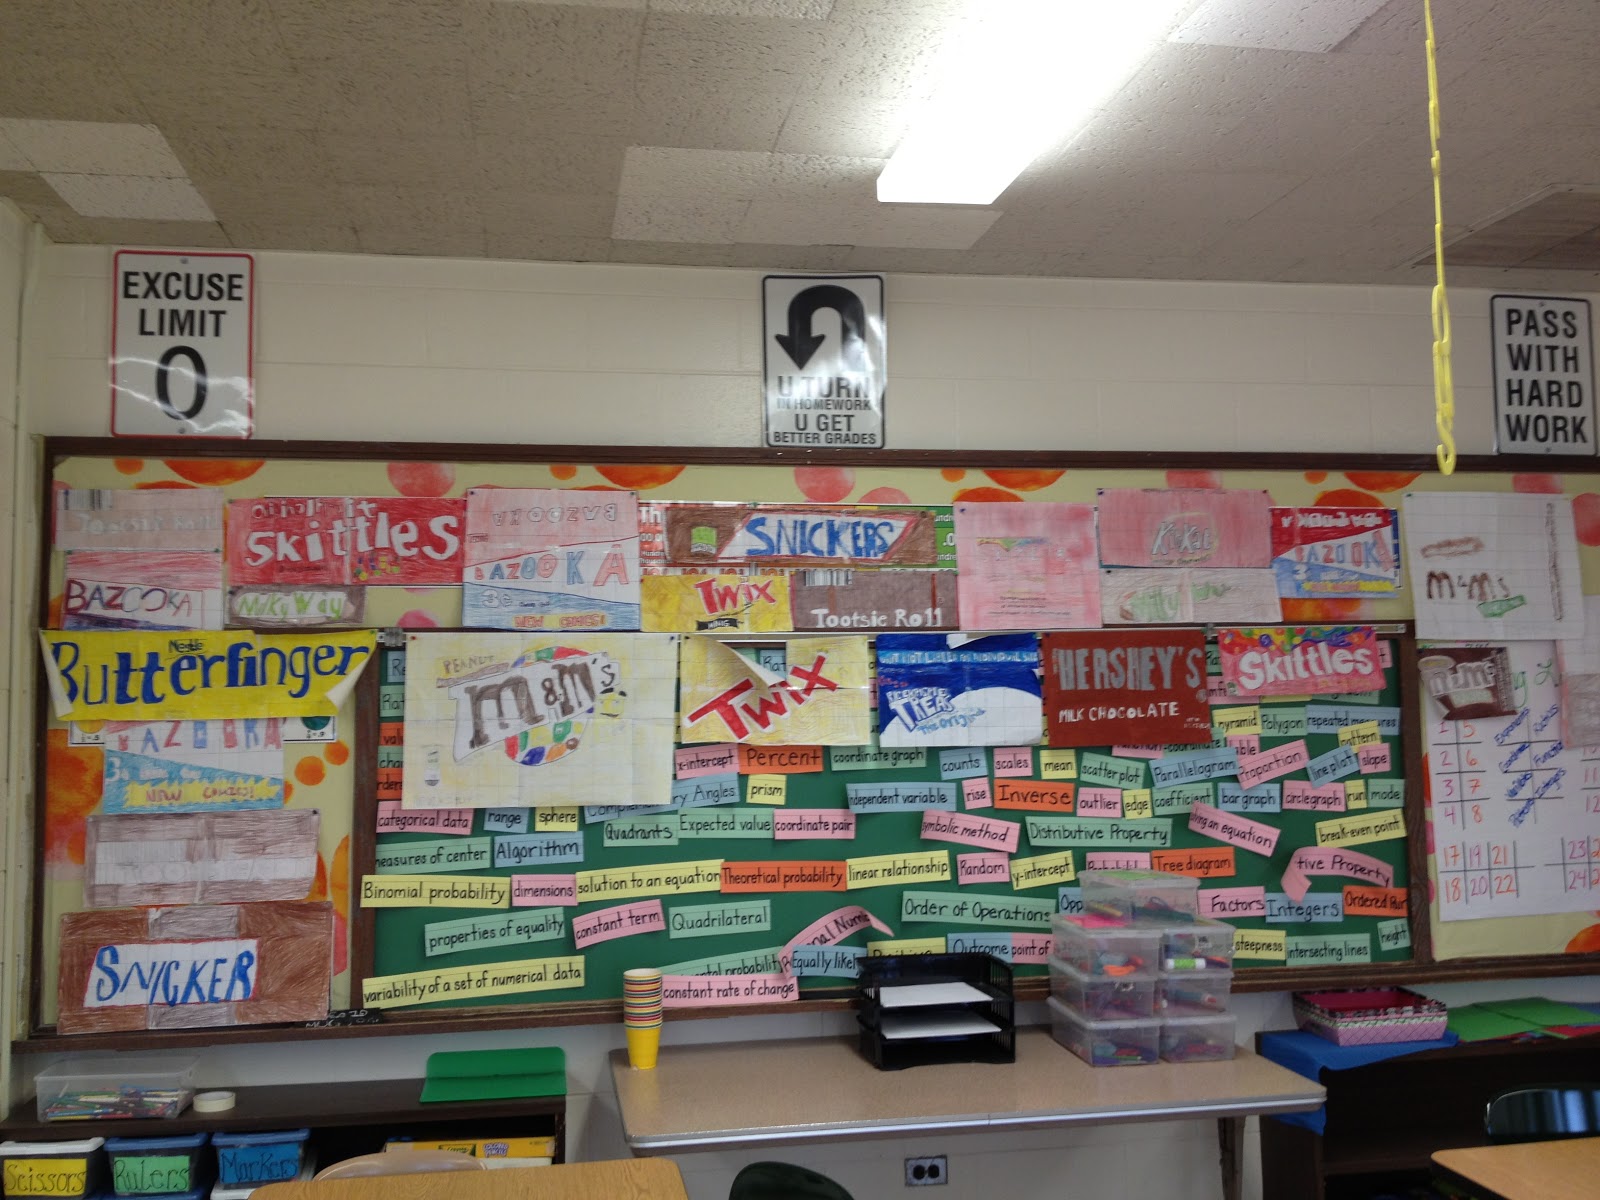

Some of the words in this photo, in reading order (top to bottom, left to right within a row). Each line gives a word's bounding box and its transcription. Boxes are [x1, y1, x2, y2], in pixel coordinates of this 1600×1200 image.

[123, 271, 244, 301] EXCUSE
[139, 309, 227, 337] LIMIT
[1506, 308, 1577, 339] PASS
[1506, 343, 1579, 373] WITH
[156, 345, 208, 421] 0
[777, 376, 793, 397] U
[1506, 379, 1583, 408] HARD
[794, 398, 871, 411] HOMEWORK
[795, 414, 808, 431] U
[816, 414, 855, 432] GET
[1505, 414, 1588, 443] WORK
[774, 432, 820, 444] BETTER
[825, 432, 876, 445] GRADES
[745, 515, 895, 558] SNICKERS
[474, 543, 630, 587] BAZOOKA
[64, 579, 193, 617] BAZOOKA
[810, 607, 889, 628] Tootsie
[50, 640, 370, 706] Butterfinger
[1053, 645, 1203, 692] HERSHEY'S
[1238, 641, 1374, 690] Skittles
[1059, 707, 1085, 723] MILK
[1089, 702, 1181, 722] CHOCOLATE
[1261, 713, 1304, 733] Polygon
[1307, 711, 1349, 729] repeated
[1463, 721, 1475, 738] 5
[676, 751, 734, 771] x-intercept
[746, 748, 821, 767] Percent
[833, 748, 889, 763] coordinate
[892, 748, 924, 767] graph
[941, 753, 981, 772] counts
[995, 752, 1029, 770] scales
[1044, 760, 1073, 772] mean
[1238, 751, 1302, 782] Proportion
[1310, 764, 1329, 781] line
[1331, 753, 1355, 777] plot
[1362, 751, 1387, 769] slope
[1440, 751, 1451, 767] 2
[1465, 749, 1478, 766] 6
[1081, 761, 1117, 780] scatter
[1118, 766, 1140, 785] plot
[1155, 758, 1236, 782] Parallelogram
[692, 783, 735, 802] Angles
[750, 782, 783, 799] prism
[902, 786, 948, 804] variable
[966, 788, 987, 802] rise
[998, 784, 1073, 805] Inverse
[1370, 784, 1400, 800] mode
[1443, 780, 1453, 796] 3
[1468, 778, 1480, 795] 7
[1079, 794, 1119, 810] outlier
[1125, 794, 1149, 815] edge
[1221, 788, 1241, 804] bar
[1242, 789, 1276, 809] graph
[1311, 788, 1342, 809] graph
[377, 809, 440, 830] categorical
[442, 812, 469, 828] data
[487, 811, 522, 828] range
[539, 807, 577, 826] sphere
[679, 814, 735, 835] Expected
[739, 818, 771, 831] value
[775, 814, 830, 832] coordinate
[832, 817, 854, 835] pair
[1444, 807, 1457, 825] 4
[1472, 805, 1484, 823] 8
[605, 823, 673, 840] Quadrants
[961, 823, 1010, 843] method
[1030, 822, 1104, 840] Distributive
[1110, 823, 1169, 846] Property
[1208, 817, 1219, 830] an
[1221, 823, 1273, 849] equation
[1374, 815, 1401, 836] point
[430, 846, 445, 864] of
[447, 844, 489, 863] center
[496, 840, 579, 864] Algorithm
[1443, 846, 1460, 867] 17
[1492, 845, 1508, 866] 21
[1568, 840, 1586, 859] 23
[849, 862, 879, 881] linear
[882, 857, 948, 880] relationship
[960, 859, 1005, 876] Random
[1012, 857, 1071, 885] y-intercept
[1153, 855, 1185, 872] Tree
[1187, 854, 1231, 876] diagram
[1331, 855, 1391, 887] Property
[578, 873, 628, 894] solution
[631, 872, 643, 888] to
[646, 877, 662, 887] an
[665, 866, 721, 890] equation
[722, 866, 781, 885] Theoretical
[783, 866, 843, 888] probability
[1470, 876, 1487, 896] 20
[1494, 873, 1516, 895] 22
[1568, 869, 1587, 890] 24
[364, 881, 423, 899] Binomial
[429, 882, 506, 905] probability
[513, 879, 574, 898] dimensions
[1445, 877, 1462, 903] 18
[904, 898, 948, 916] Order
[952, 901, 968, 917] of
[972, 901, 1050, 923] Operations
[1212, 895, 1265, 912] Factors
[1267, 900, 1340, 922] Integers
[1345, 891, 1388, 910] Ordered
[575, 911, 623, 940] constant
[629, 909, 660, 924] term
[671, 906, 767, 932] Quadrilateral
[429, 923, 496, 952] properties
[500, 919, 513, 937] of
[516, 914, 565, 940] equality
[1381, 927, 1408, 946] height
[953, 939, 1009, 955] Outcome
[1011, 942, 1036, 957] point
[1038, 940, 1051, 955] of
[1235, 936, 1283, 953] steepness
[1287, 940, 1343, 963] intersecting
[1344, 941, 1369, 956] lines
[792, 951, 831, 975] Equally
[95, 945, 254, 1007] SNICKER
[364, 978, 426, 1002] variability
[428, 975, 441, 994] of
[444, 982, 451, 992] a
[454, 972, 473, 991] set
[475, 970, 488, 989] of
[491, 964, 548, 987] numerical
[553, 962, 582, 981] data
[663, 981, 713, 999] constant
[716, 981, 740, 997] rate
[744, 980, 757, 996] of
[758, 980, 795, 999] change
[3, 1162, 88, 1192] Scissors
[114, 1159, 191, 1192] Rulers
[221, 1153, 298, 1182] Markers
